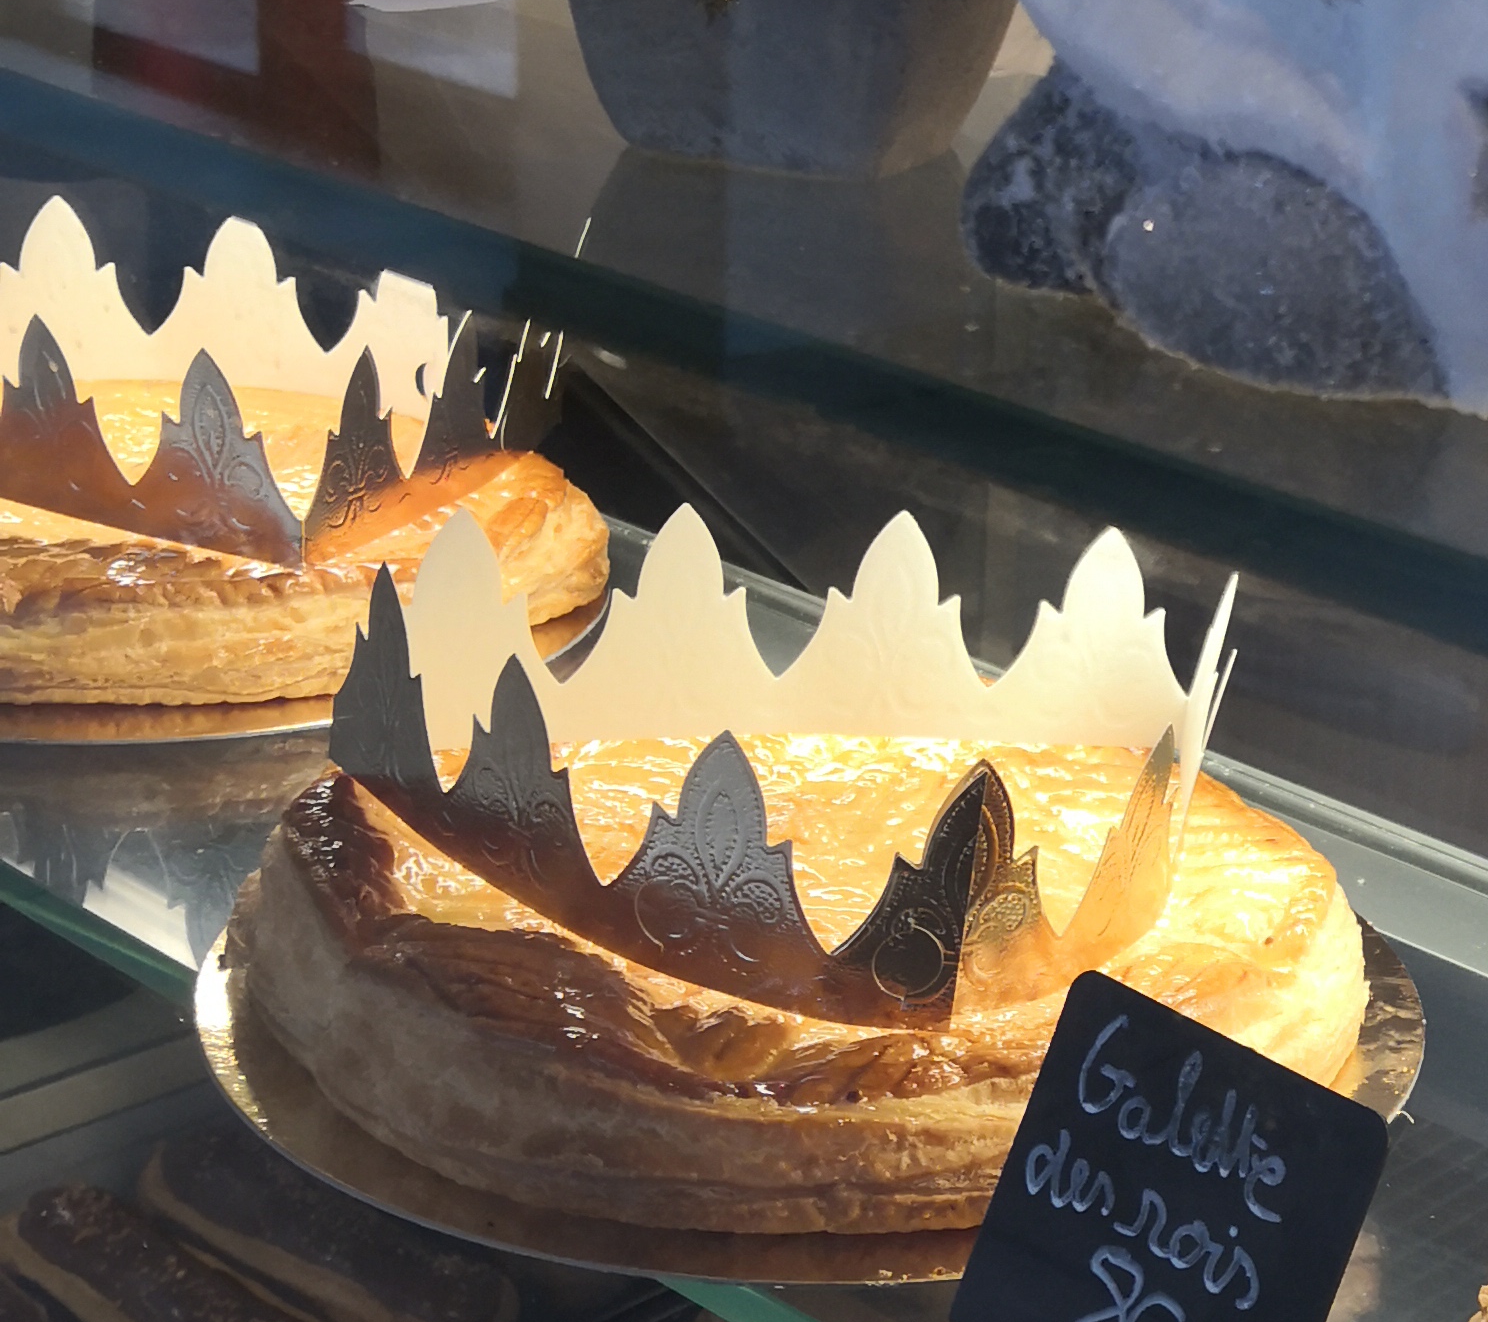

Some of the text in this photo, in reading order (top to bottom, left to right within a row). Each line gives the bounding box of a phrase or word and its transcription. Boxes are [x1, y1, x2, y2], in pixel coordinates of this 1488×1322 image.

[1078, 1013, 1288, 1224] Galette
[1025, 1128, 1261, 1311] des rois
